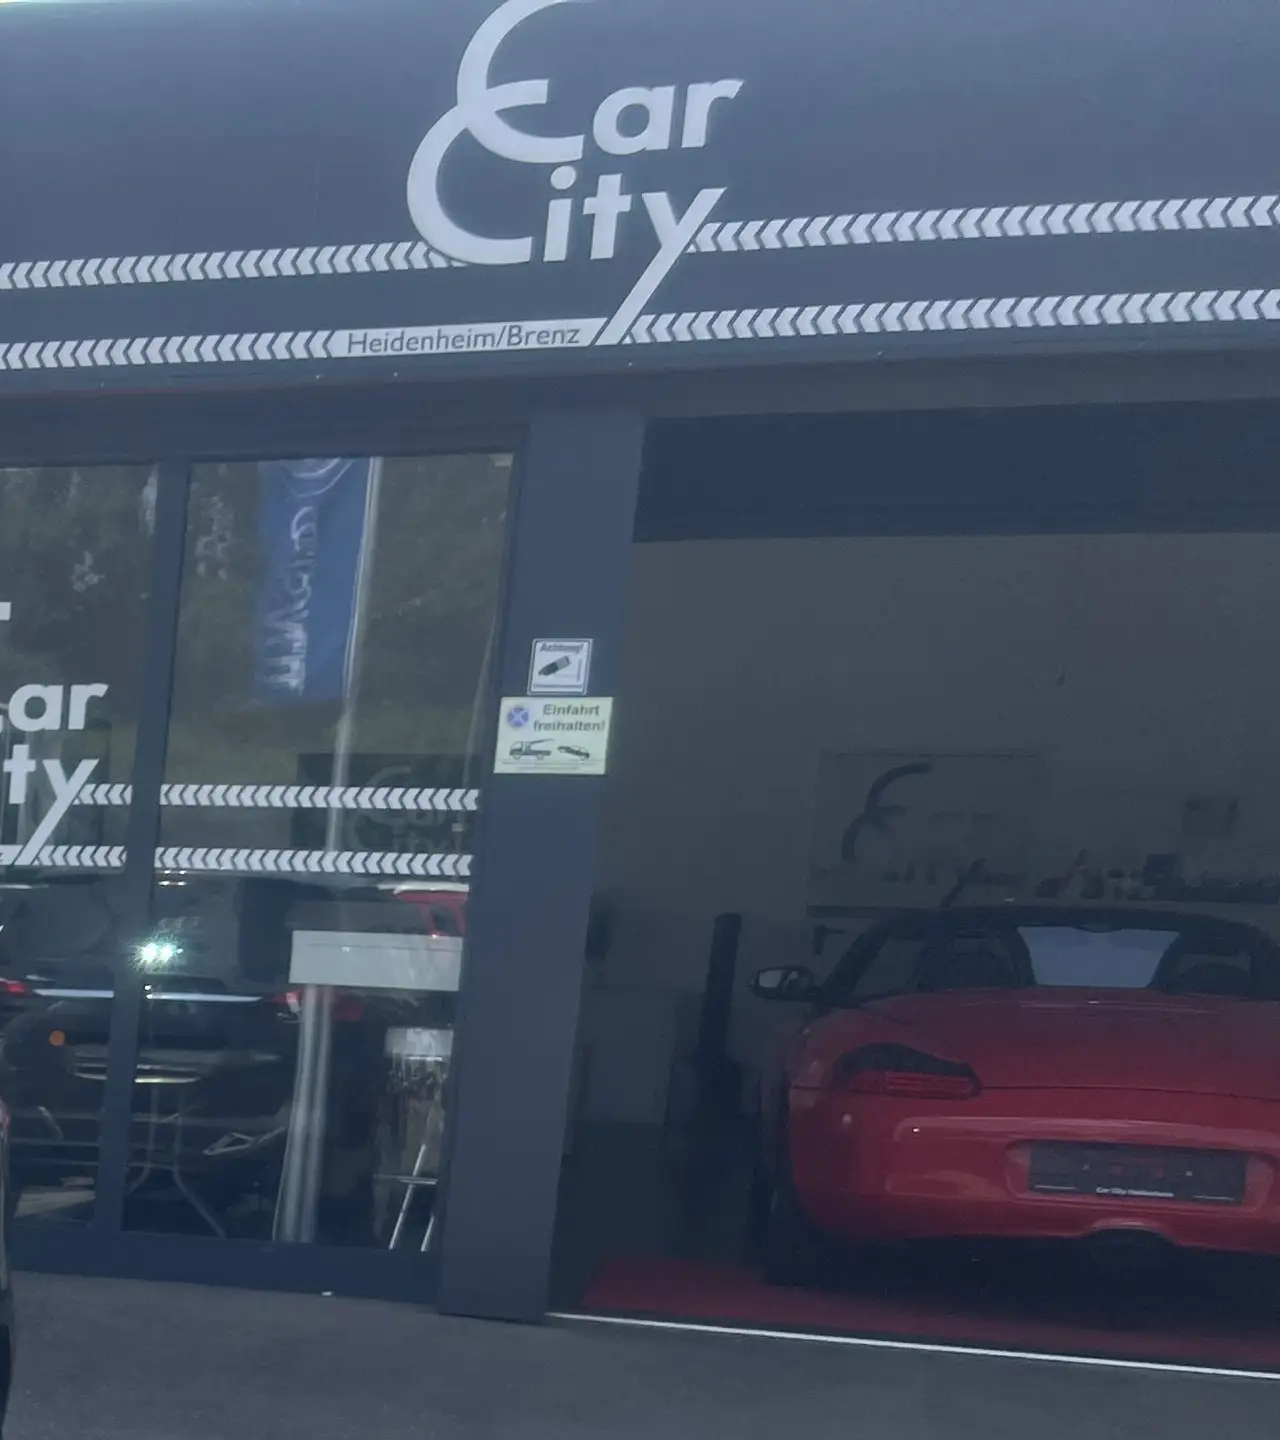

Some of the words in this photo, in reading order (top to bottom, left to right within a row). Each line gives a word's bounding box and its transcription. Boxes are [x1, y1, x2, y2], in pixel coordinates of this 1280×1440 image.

[457, 0, 744, 163] Car
[407, 105, 728, 345] City
[347, 325, 580, 354] Heidenheim/Brenz
[543, 704, 601, 716] Einfahrt
